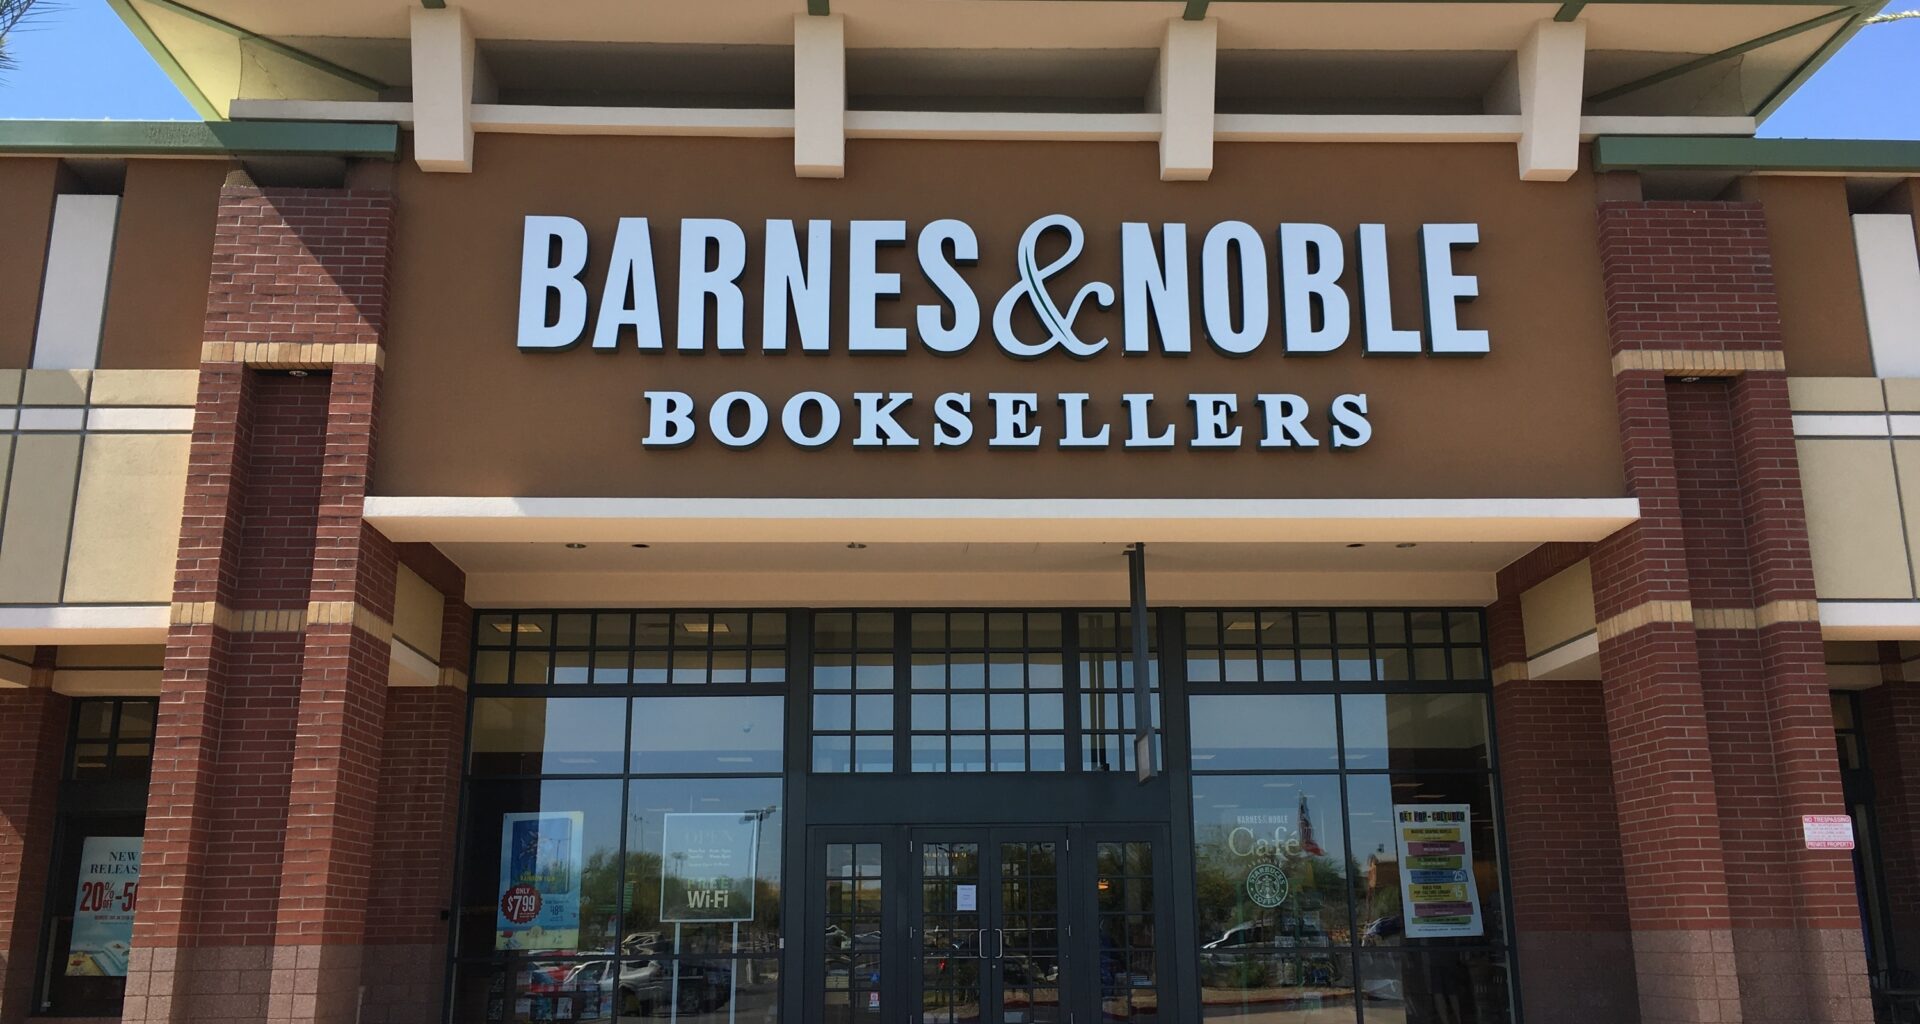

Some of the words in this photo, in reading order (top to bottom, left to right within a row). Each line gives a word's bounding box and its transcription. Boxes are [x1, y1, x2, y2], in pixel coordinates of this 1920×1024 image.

[516, 214, 981, 355] BARNES
[992, 213, 1115, 358] &
[1121, 219, 1490, 358] NOBLE
[642, 390, 1373, 449] BOOKSELLERS
[1228, 826, 1300, 857] Café
[109, 851, 138, 862] NEW
[90, 864, 138, 874] RELEAS
[1249, 866, 1286, 885] STARBUCKS
[79, 881, 114, 912] 20%
[687, 890, 729, 909] Wi-Fi
[1253, 893, 1282, 905] COFFEE
